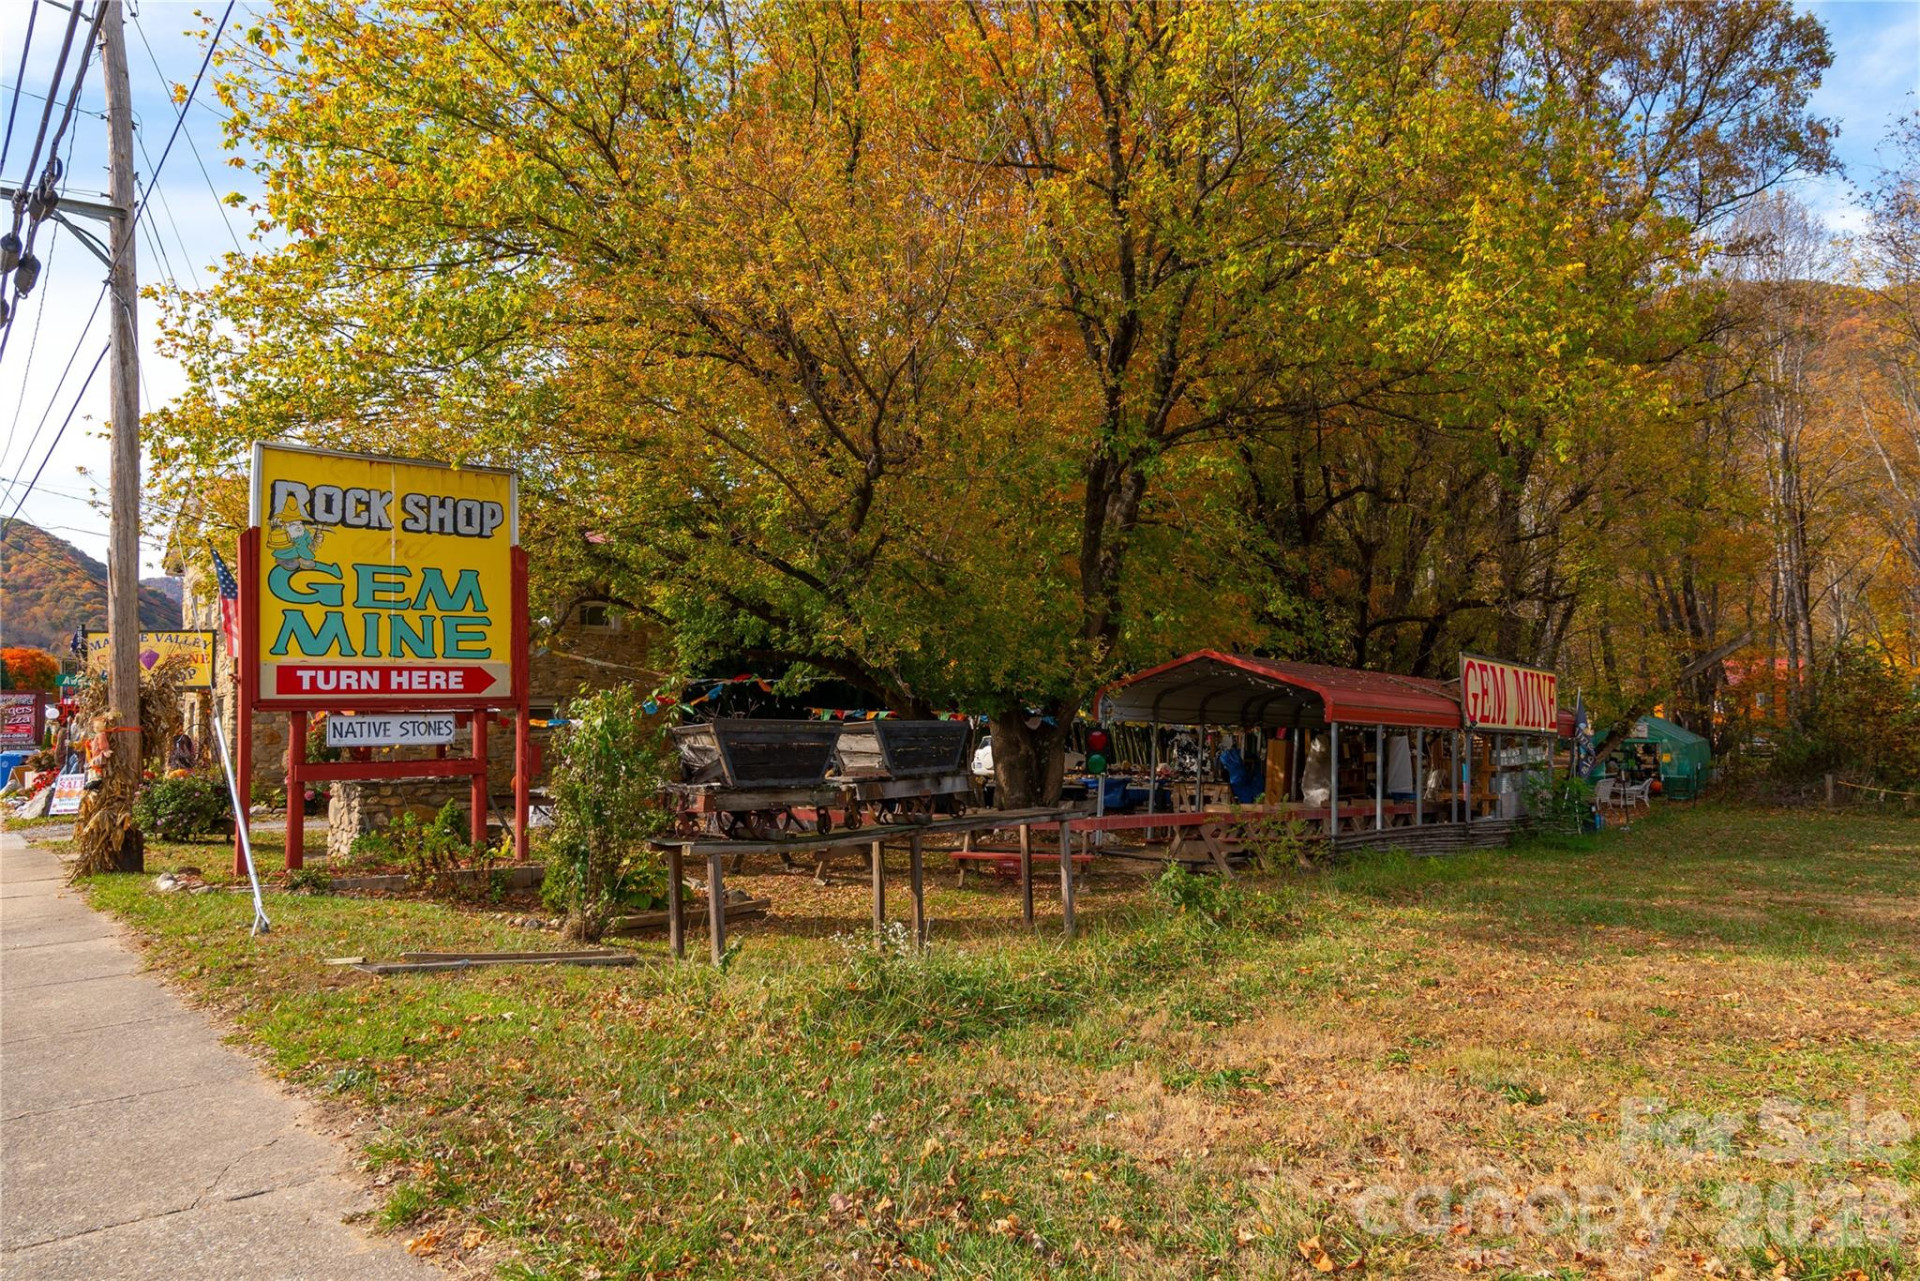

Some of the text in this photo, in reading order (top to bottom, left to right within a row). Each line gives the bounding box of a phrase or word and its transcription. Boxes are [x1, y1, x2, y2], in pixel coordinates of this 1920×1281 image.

[270, 479, 504, 538] ROCK SHOP
[268, 561, 488, 613] GEM
[155, 633, 212, 650] VALLEY
[269, 609, 492, 659] MINE
[296, 670, 464, 690] TURN HERE
[1464, 659, 1557, 730] GEM MINE
[332, 720, 453, 739] NATIVE STONES
